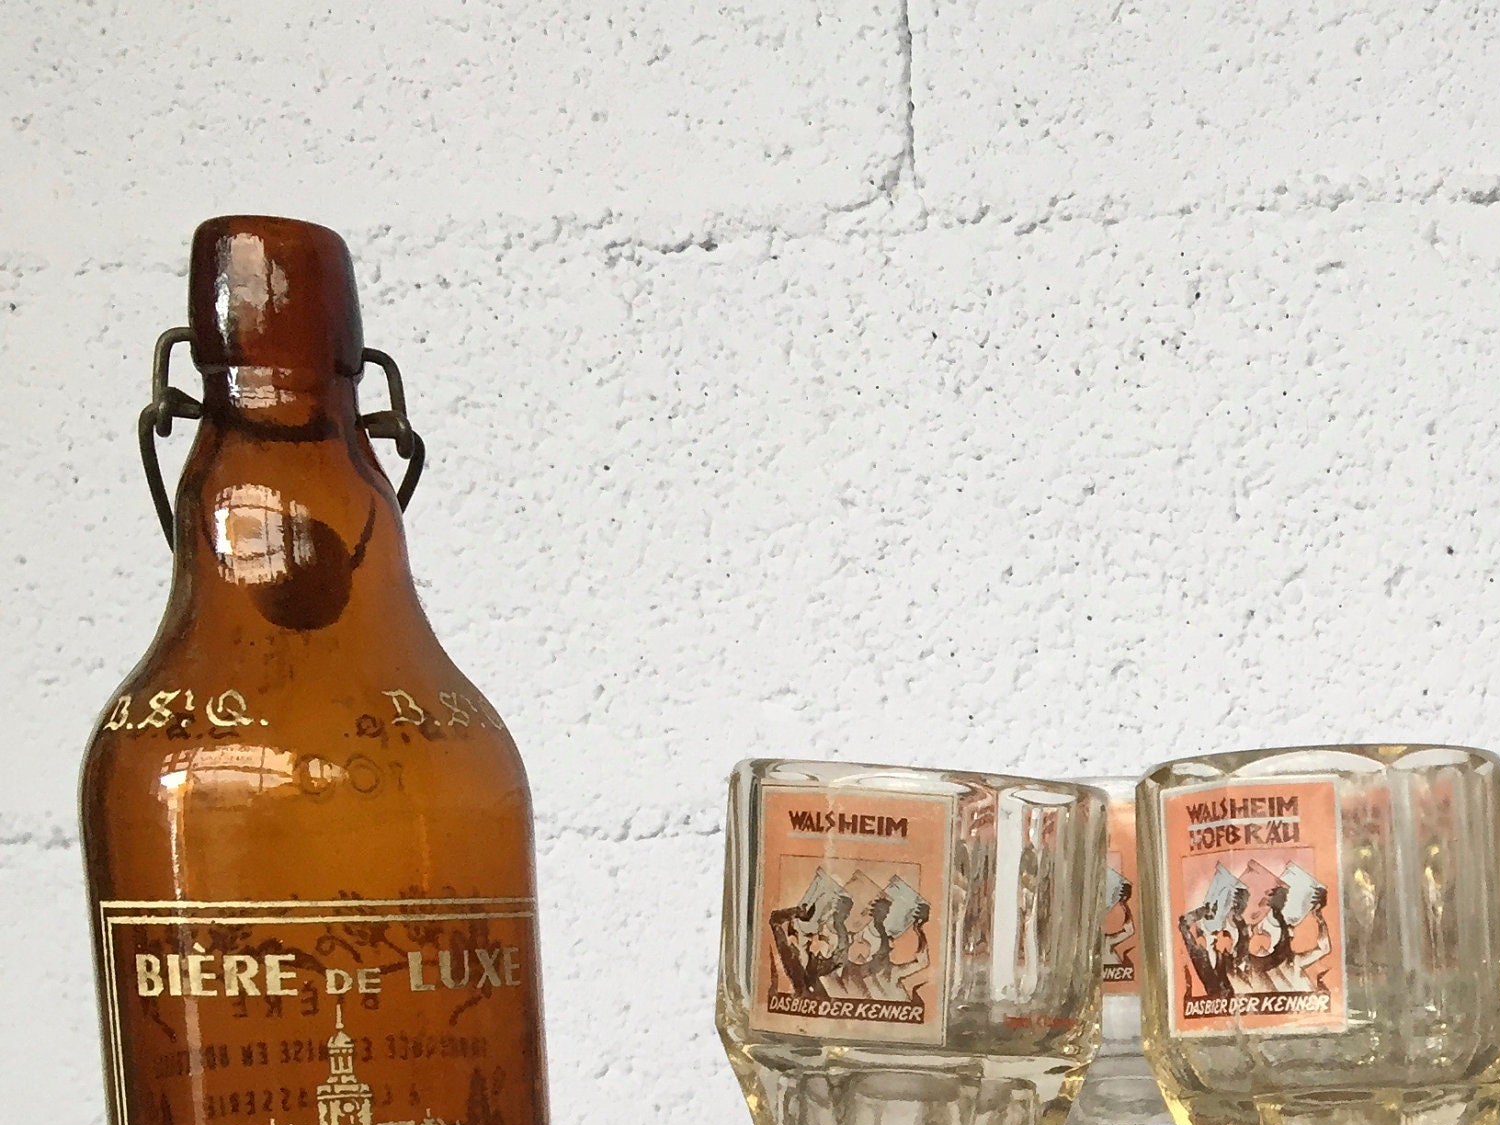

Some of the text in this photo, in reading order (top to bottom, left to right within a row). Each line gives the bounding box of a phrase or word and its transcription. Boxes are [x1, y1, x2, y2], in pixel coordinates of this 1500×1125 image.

[789, 809, 908, 838] WALSHEIM
[1186, 796, 1299, 824] WALSHEIM
[1188, 820, 1301, 851] HOFBRÄU
[136, 943, 522, 998] BIÈRE DE LUXE
[818, 1000, 854, 1018] DER
[855, 1002, 924, 1022] KENNER
[1228, 996, 1260, 1015] DER
[1261, 994, 1330, 1014] KENNER
